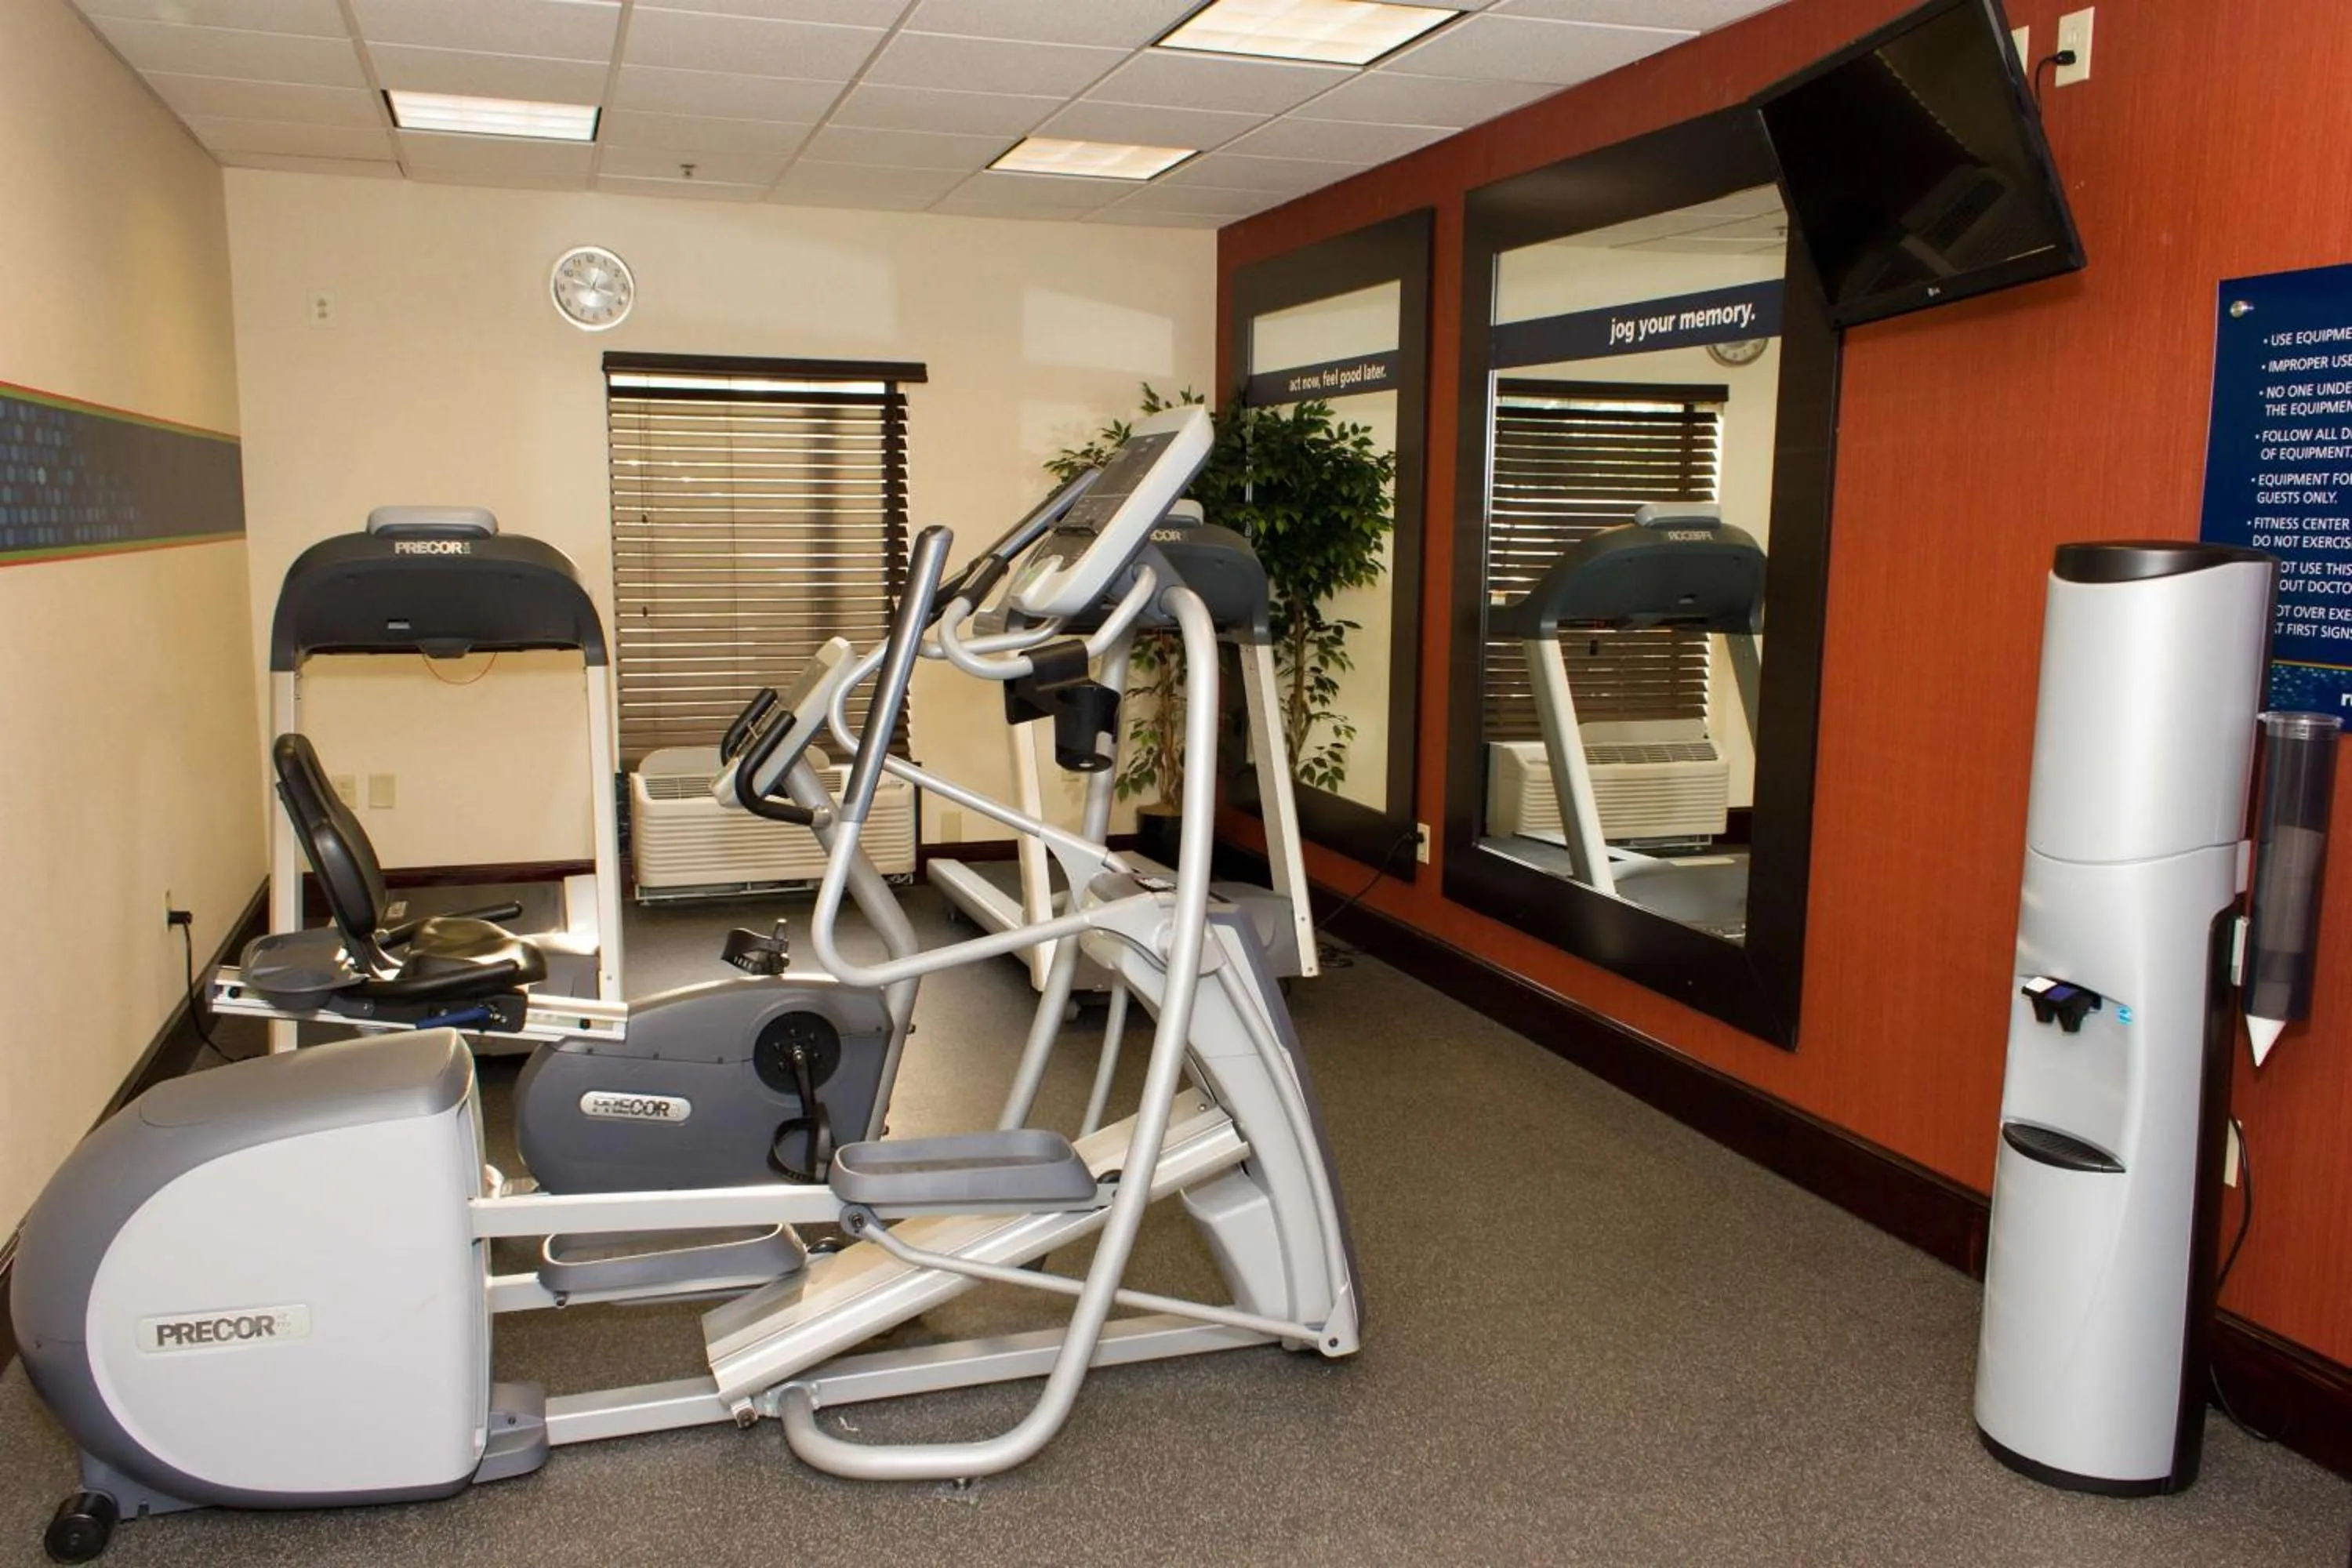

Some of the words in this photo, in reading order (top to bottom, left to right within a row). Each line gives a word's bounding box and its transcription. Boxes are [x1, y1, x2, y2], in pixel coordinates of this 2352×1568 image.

[1610, 318, 1635, 345] jog
[1639, 314, 1676, 341] your
[1679, 303, 1756, 330] memory.
[2271, 333, 2293, 346] USE
[2268, 357, 2328, 372] IMPROPER
[1289, 376, 1301, 391] act
[1323, 368, 1338, 387] feel
[1340, 364, 1363, 388] good
[2266, 387, 2285, 398] NO
[2287, 384, 2314, 397] ONE
[2265, 405, 2287, 416] THE
[2262, 430, 2313, 442] FOLLOW
[2314, 428, 2337, 440] ALL
[2260, 448, 2278, 460] OF
[2258, 474, 2330, 487] EQUIPMENT
[2332, 473, 2352, 485] FO
[2256, 492, 2300, 504] GUESTS
[2303, 492, 2338, 504] ONLY.
[2254, 517, 2299, 530] FITNESS
[2303, 518, 2350, 531] CENTER
[1150, 528, 1182, 541] COR
[394, 541, 463, 554] PRECOR
[2252, 535, 2271, 546] DO
[2274, 536, 2300, 548] NOT
[2303, 536, 2352, 550] EXERCIS
[2281, 562, 2297, 574] OT
[2299, 563, 2322, 575] USE
[2277, 605, 2292, 618] OT
[2293, 606, 2326, 619] OVER
[2286, 624, 2319, 637] FIRST
[156, 1315, 276, 1346] PRECOR
